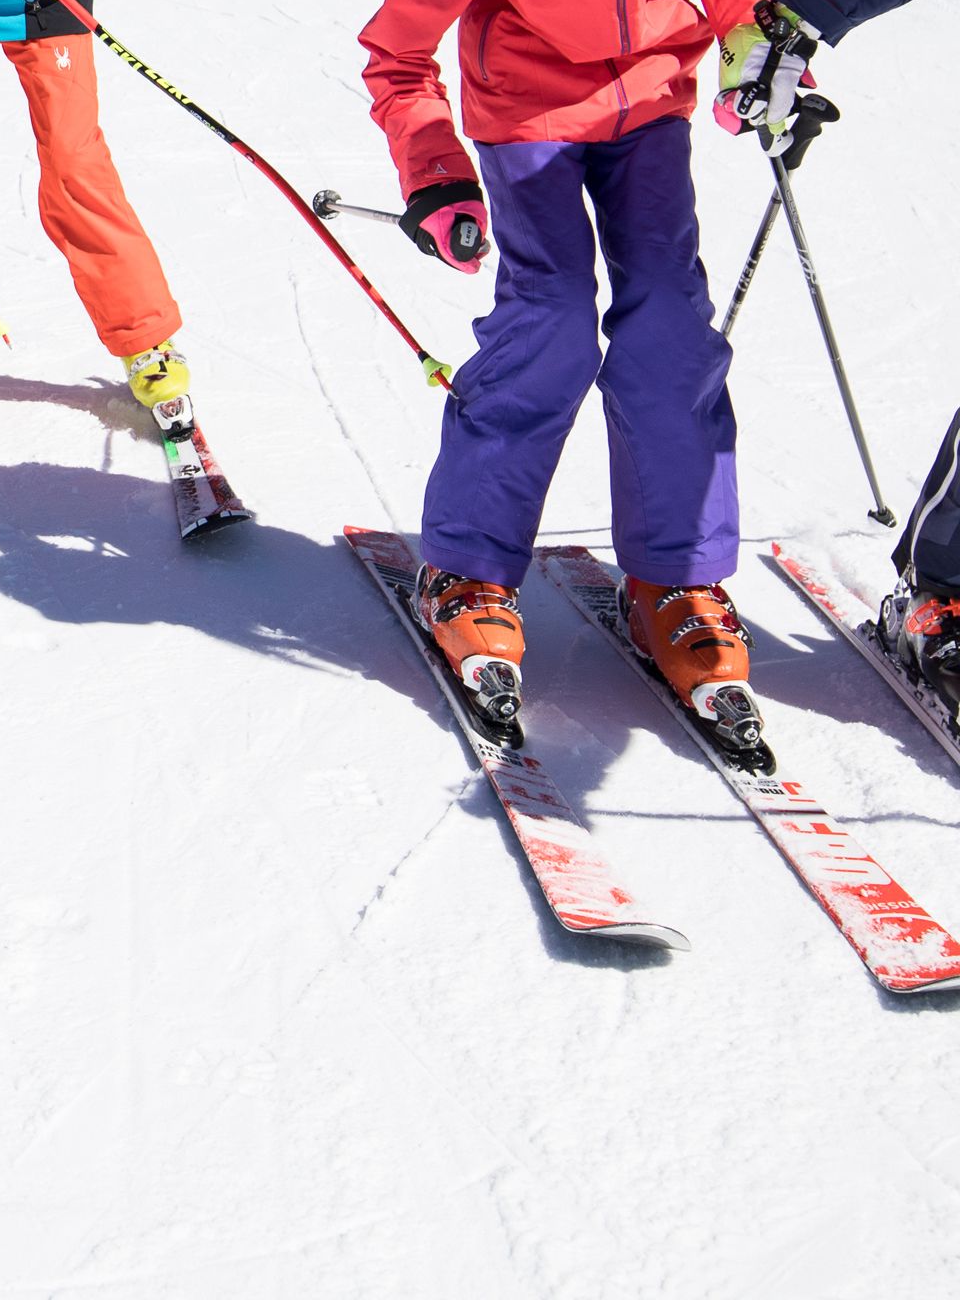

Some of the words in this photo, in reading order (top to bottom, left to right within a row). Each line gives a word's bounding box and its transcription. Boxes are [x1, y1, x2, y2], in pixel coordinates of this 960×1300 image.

[740, 87, 758, 113] LEKI
[465, 225, 473, 244] LEKI
[737, 256, 758, 293] LEKI
